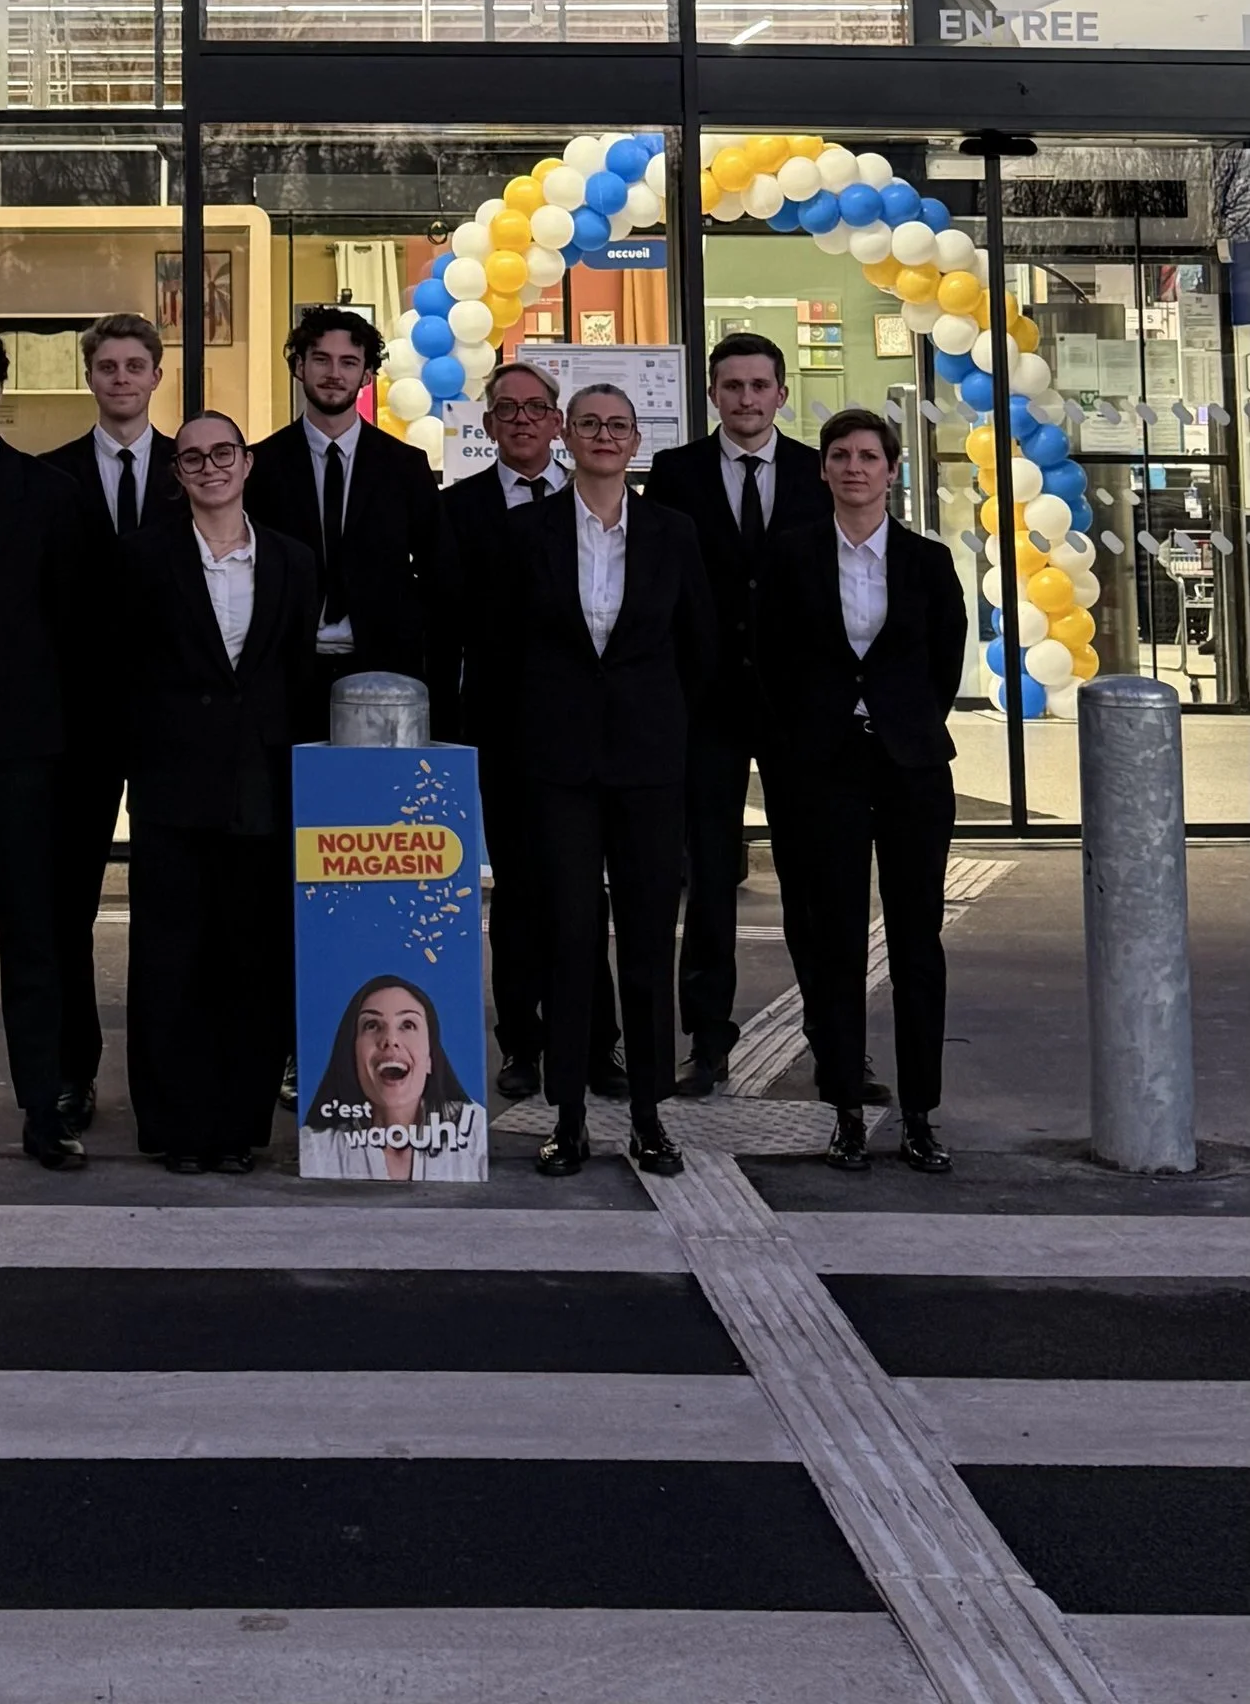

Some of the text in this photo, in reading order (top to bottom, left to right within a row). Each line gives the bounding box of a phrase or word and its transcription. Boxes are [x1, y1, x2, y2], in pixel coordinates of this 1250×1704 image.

[939, 9, 1099, 42] ENTREE
[607, 247, 650, 259] accueil
[317, 831, 446, 853] NOUVEAU
[322, 854, 443, 876] MAGASIN
[320, 1099, 373, 1119] c'est
[344, 1103, 474, 1152] waouh!
